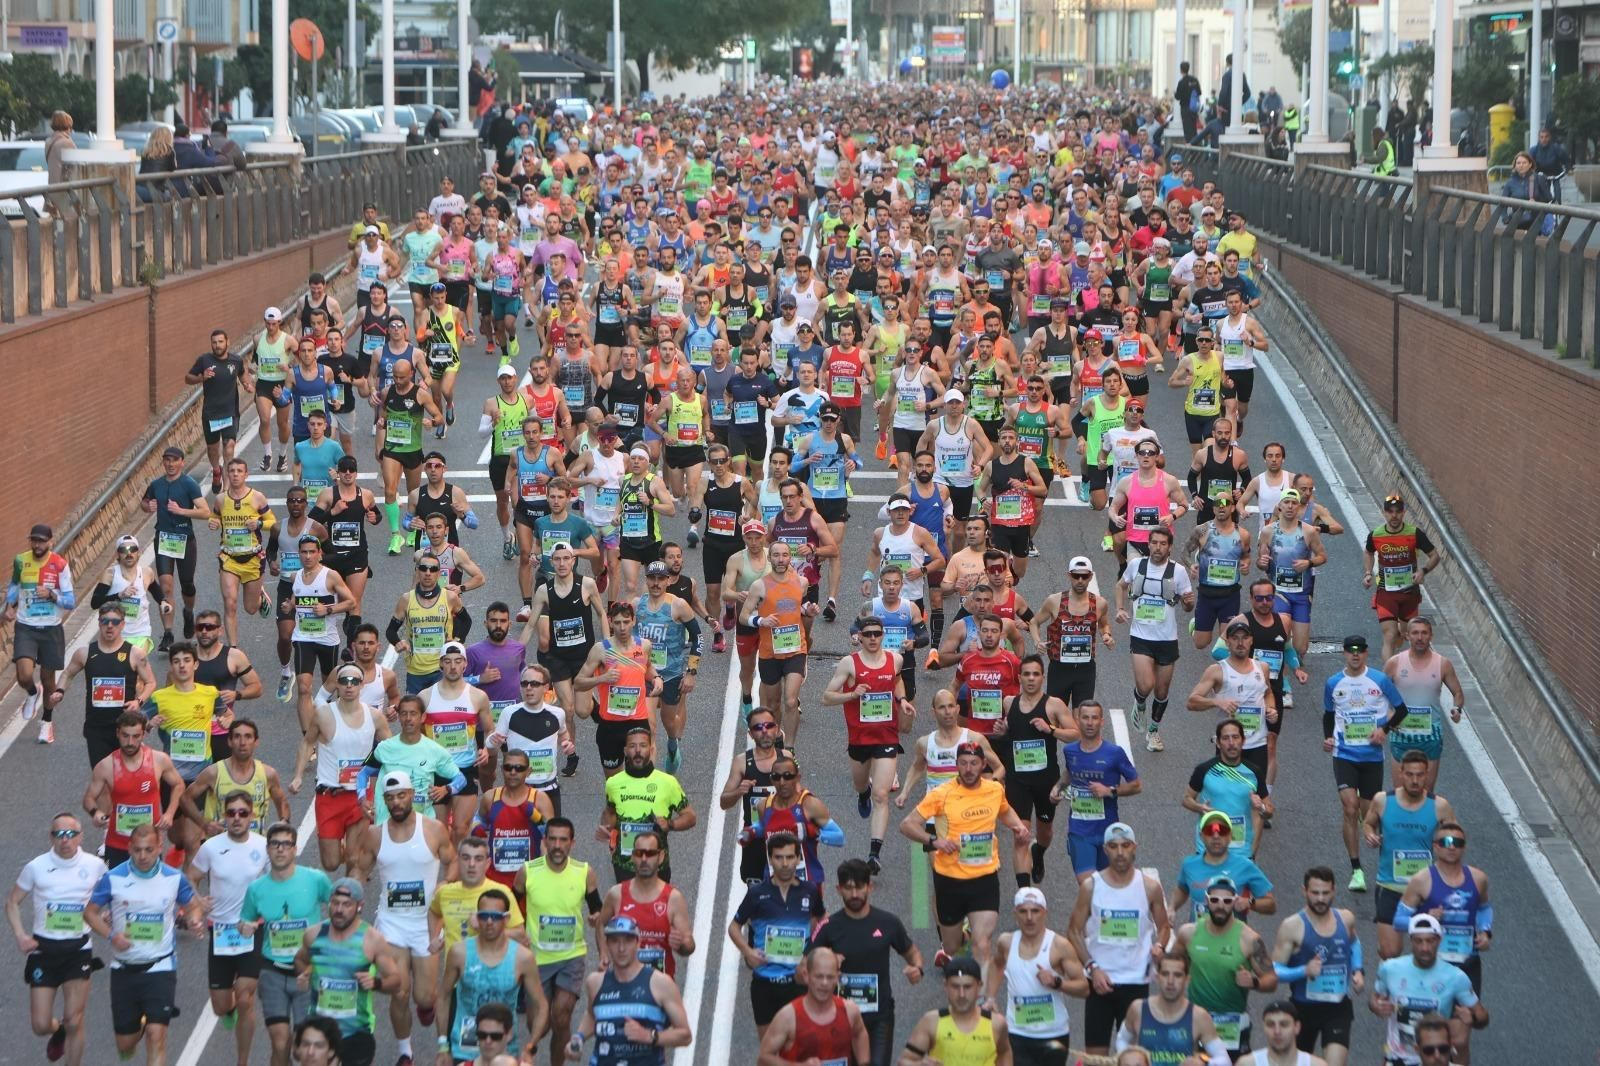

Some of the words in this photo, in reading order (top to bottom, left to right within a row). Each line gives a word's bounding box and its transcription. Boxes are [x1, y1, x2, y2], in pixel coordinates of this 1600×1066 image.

[298, 597, 318, 606] ASM
[970, 673, 1002, 681] BCTEAM
[495, 828, 528, 838] Pequiven
[850, 976, 872, 984] ZURICH
